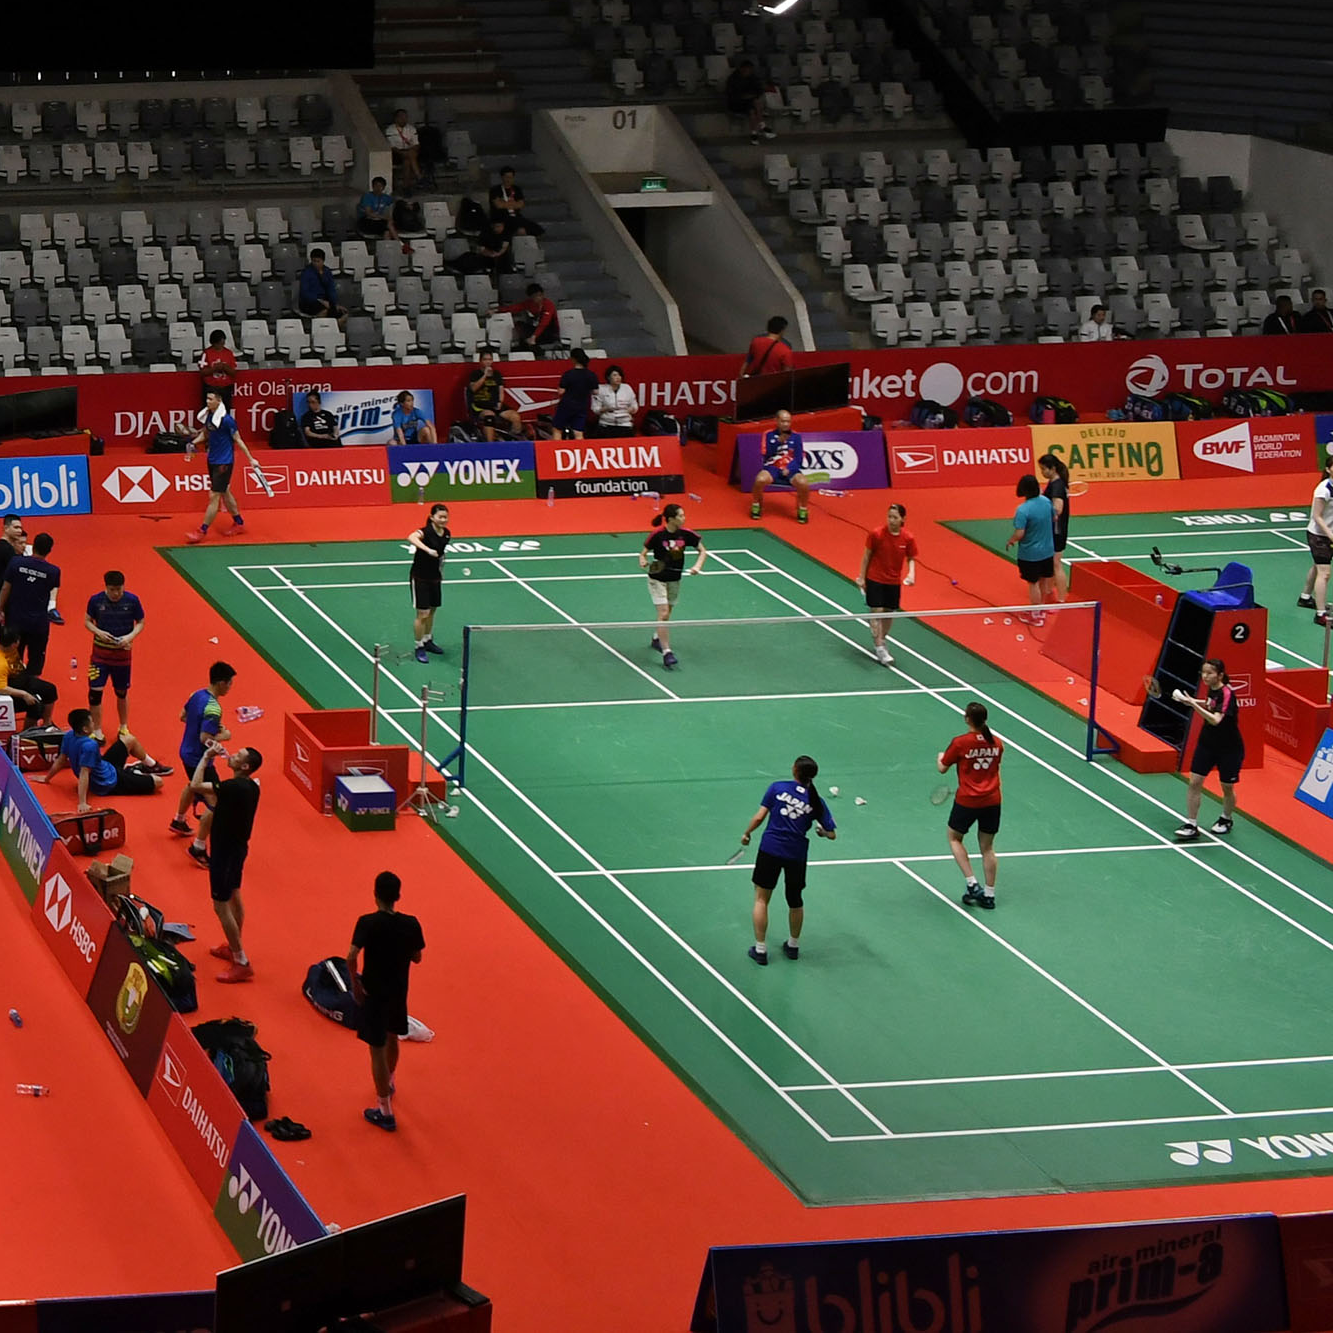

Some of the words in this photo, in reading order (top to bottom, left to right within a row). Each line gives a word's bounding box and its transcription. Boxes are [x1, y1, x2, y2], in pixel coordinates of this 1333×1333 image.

[613, 109, 637, 129] 01
[1176, 363, 1298, 390] TOTAL
[360, 394, 399, 408] minera
[639, 380, 736, 407] IHATS
[1080, 427, 1126, 439] DELIZIO
[1252, 433, 1301, 443] BADMINTON
[1201, 440, 1247, 455] BWF
[1253, 442, 1283, 452] WORLD
[1254, 449, 1302, 459] FEDERATION
[554, 446, 662, 473] DJARUM
[943, 447, 1031, 467] DAIHATSU
[295, 468, 385, 487] DAIHATSU
[444, 458, 521, 486] YONEX
[174, 474, 212, 491] HSB
[574, 478, 648, 495] foundation
[1234, 625, 1245, 639] 2
[965, 747, 1000, 759] JAPAN
[776, 792, 813, 815] JAPAN
[16, 817, 46, 886] YONEX
[70, 916, 97, 964] HSBC
[181, 1086, 230, 1168] DAIHATSU
